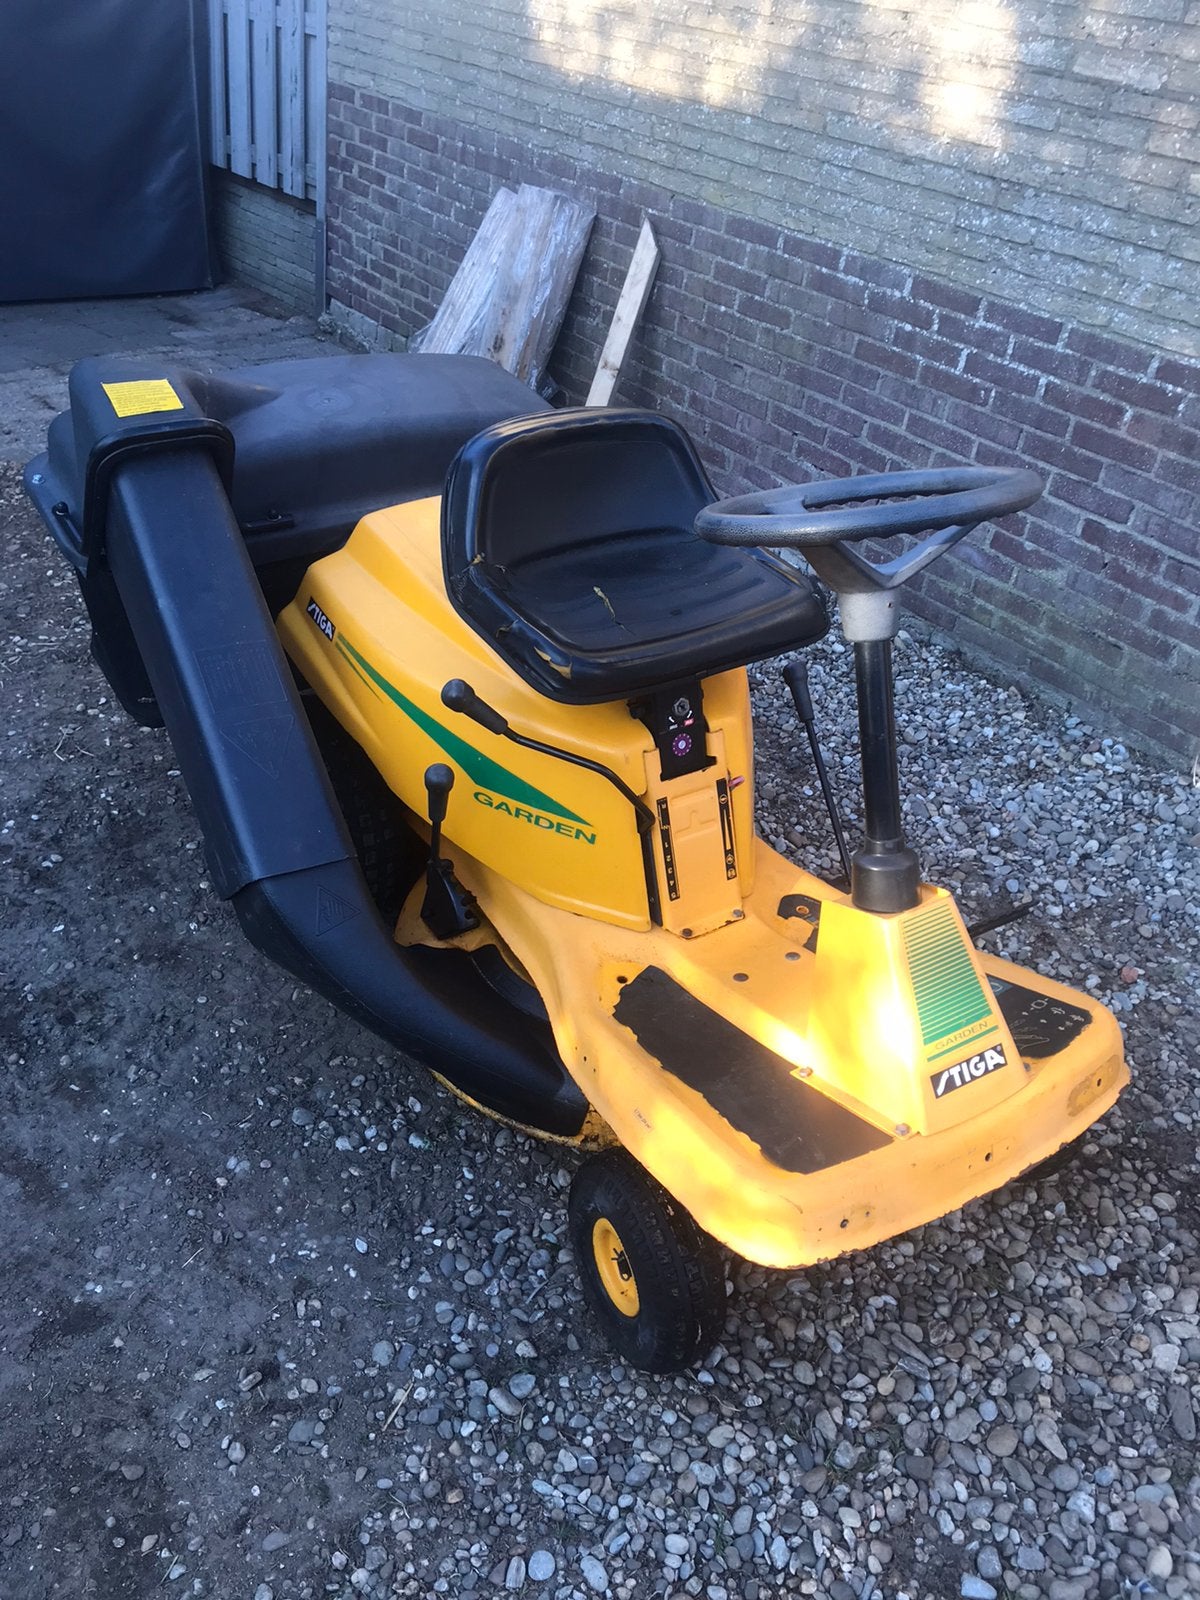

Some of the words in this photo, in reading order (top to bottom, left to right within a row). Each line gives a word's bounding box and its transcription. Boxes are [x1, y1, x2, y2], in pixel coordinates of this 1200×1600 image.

[307, 603, 333, 640] STIGA
[473, 791, 597, 845] GARDEN
[935, 1020, 988, 1050] GARDEN
[936, 1049, 1006, 1096] STIGA
